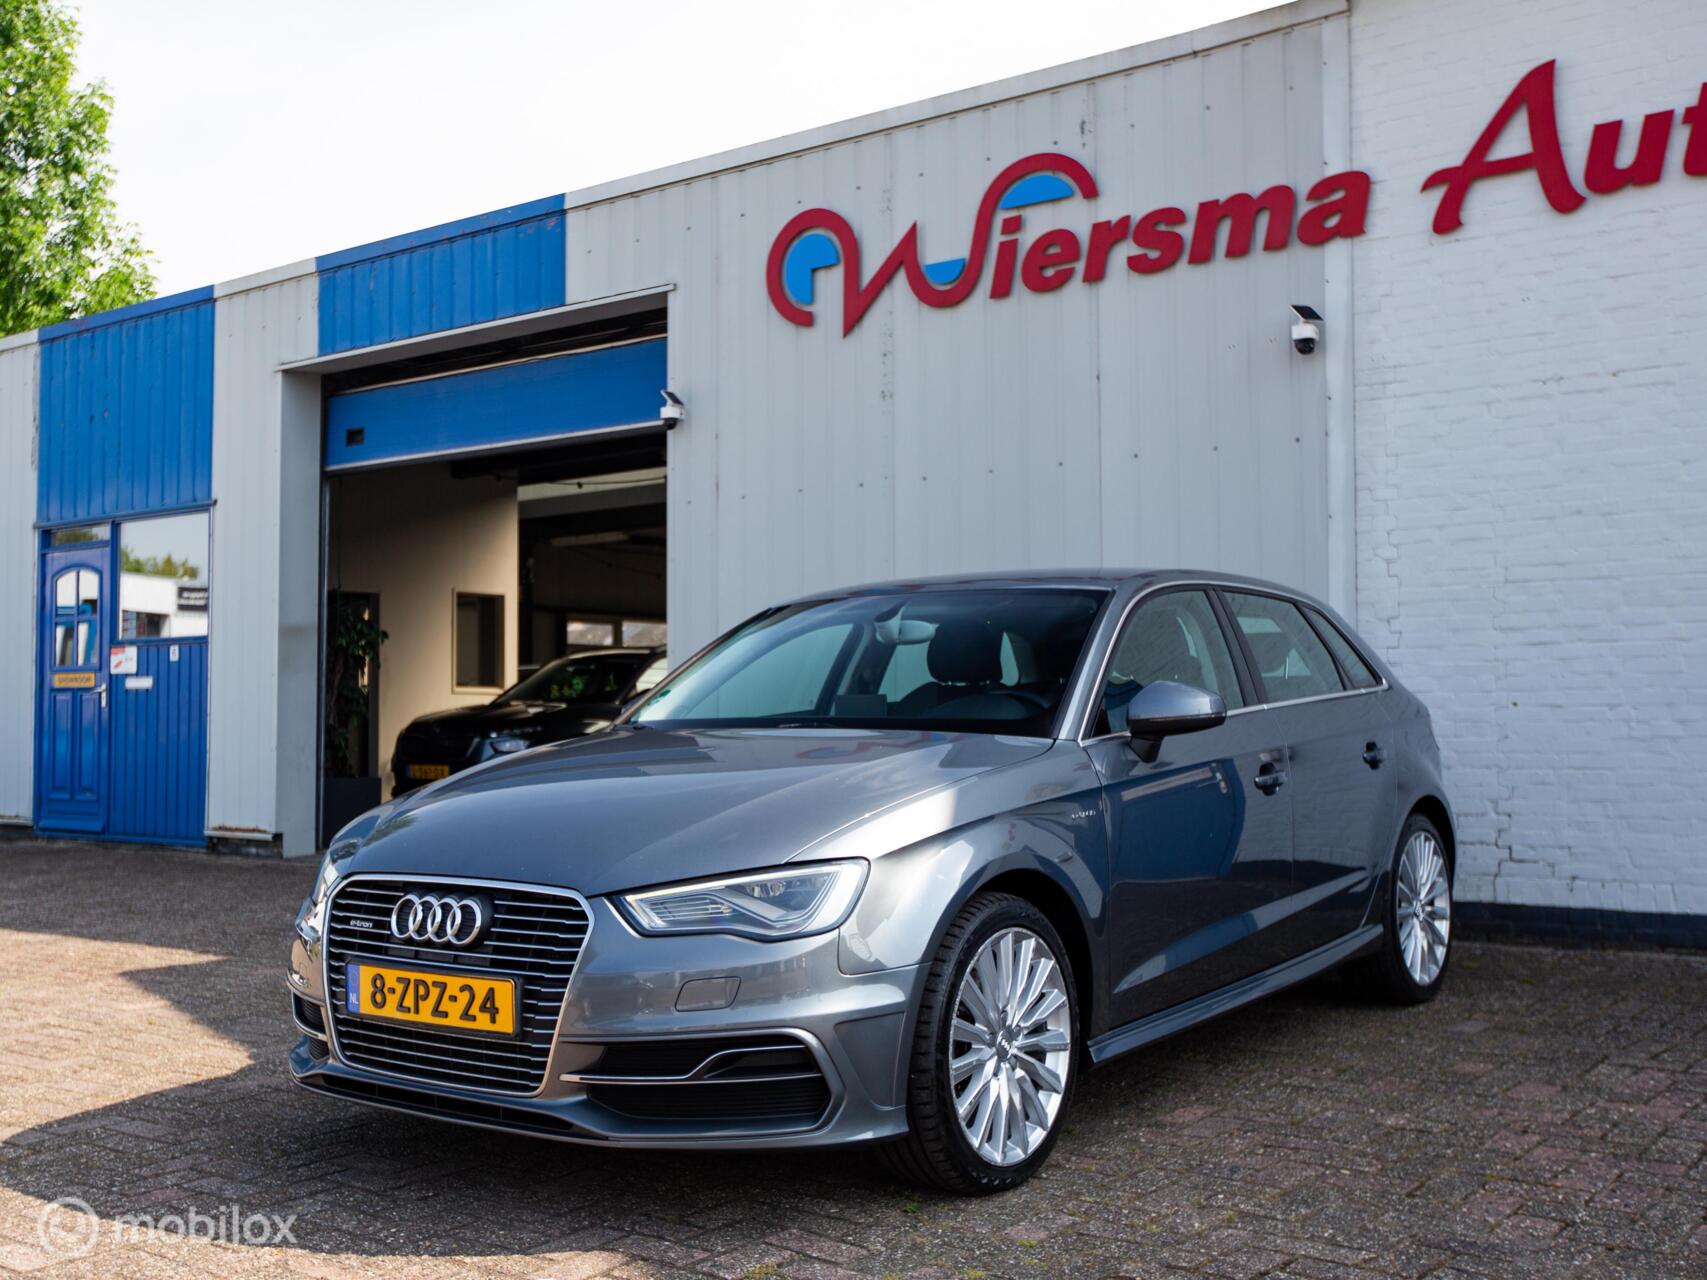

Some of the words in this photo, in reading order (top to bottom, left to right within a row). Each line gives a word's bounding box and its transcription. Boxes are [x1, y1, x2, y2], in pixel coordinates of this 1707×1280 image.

[766, 152, 1372, 339] Wiersma
[350, 992, 359, 1004] NL
[370, 973, 499, 1024] 8-ZPZ-24
